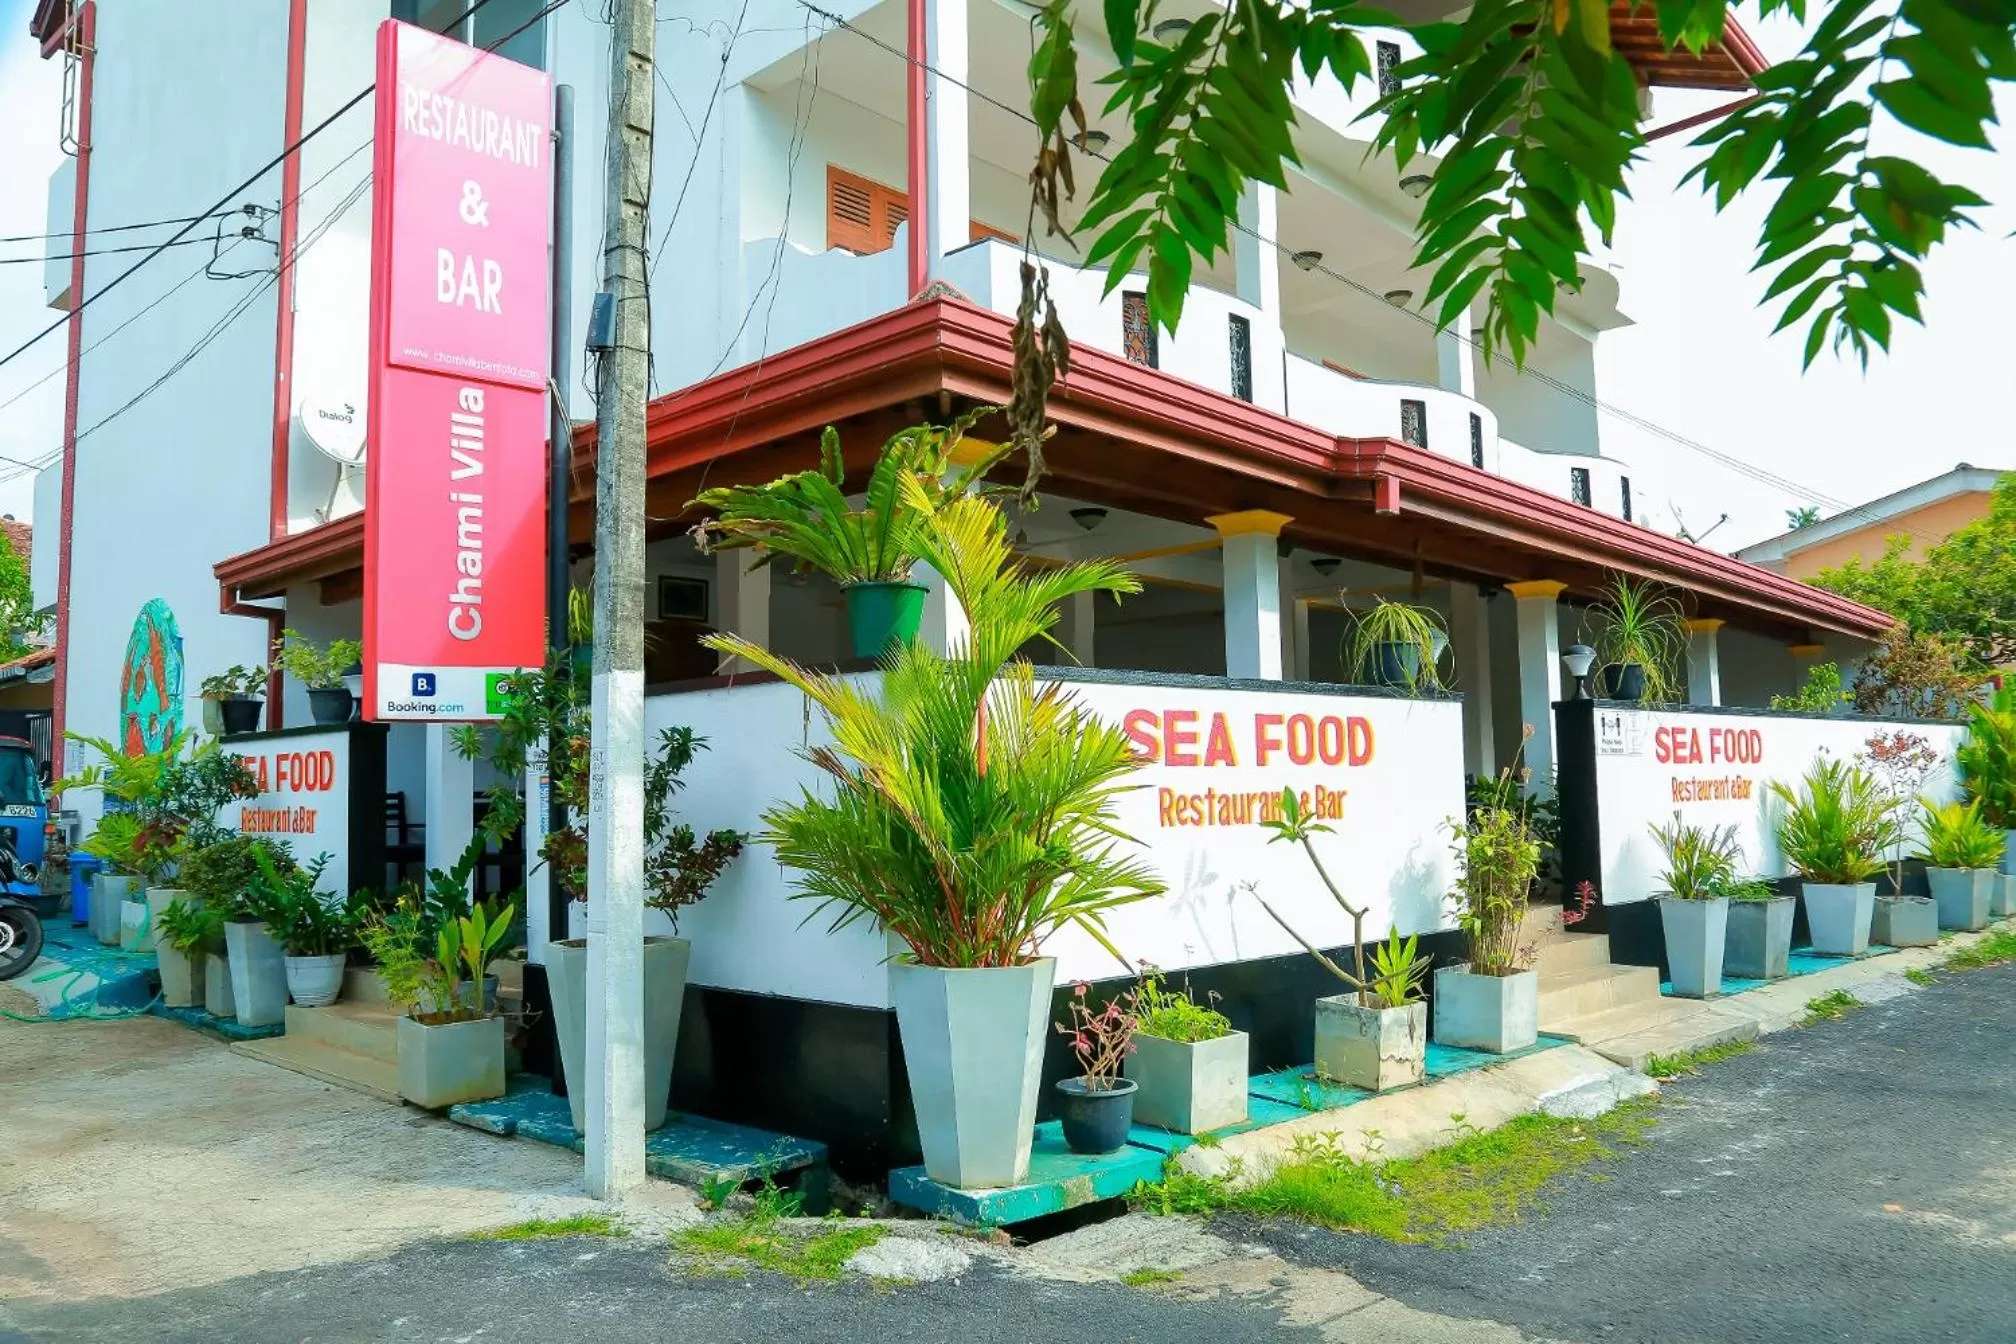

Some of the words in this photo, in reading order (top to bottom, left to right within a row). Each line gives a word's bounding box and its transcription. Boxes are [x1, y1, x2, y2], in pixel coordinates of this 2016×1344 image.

[403, 84, 541, 168] RESTAURANT
[459, 179, 489, 227] &
[437, 248, 503, 315] BAR
[450, 386, 486, 482] Villa
[448, 493, 484, 641] Chami
[387, 701, 465, 714] Booking.com
[1123, 708, 1239, 767] SEA
[1255, 713, 1375, 767] FOOD
[1655, 726, 1704, 764] SEA
[1709, 728, 1762, 764] FOOD
[276, 750, 335, 793] FOOD
[1672, 775, 1729, 802] Restaurant
[242, 806, 290, 833] Restaurant
[1159, 786, 1287, 828] Restauran
[1315, 784, 1347, 820] Bar
